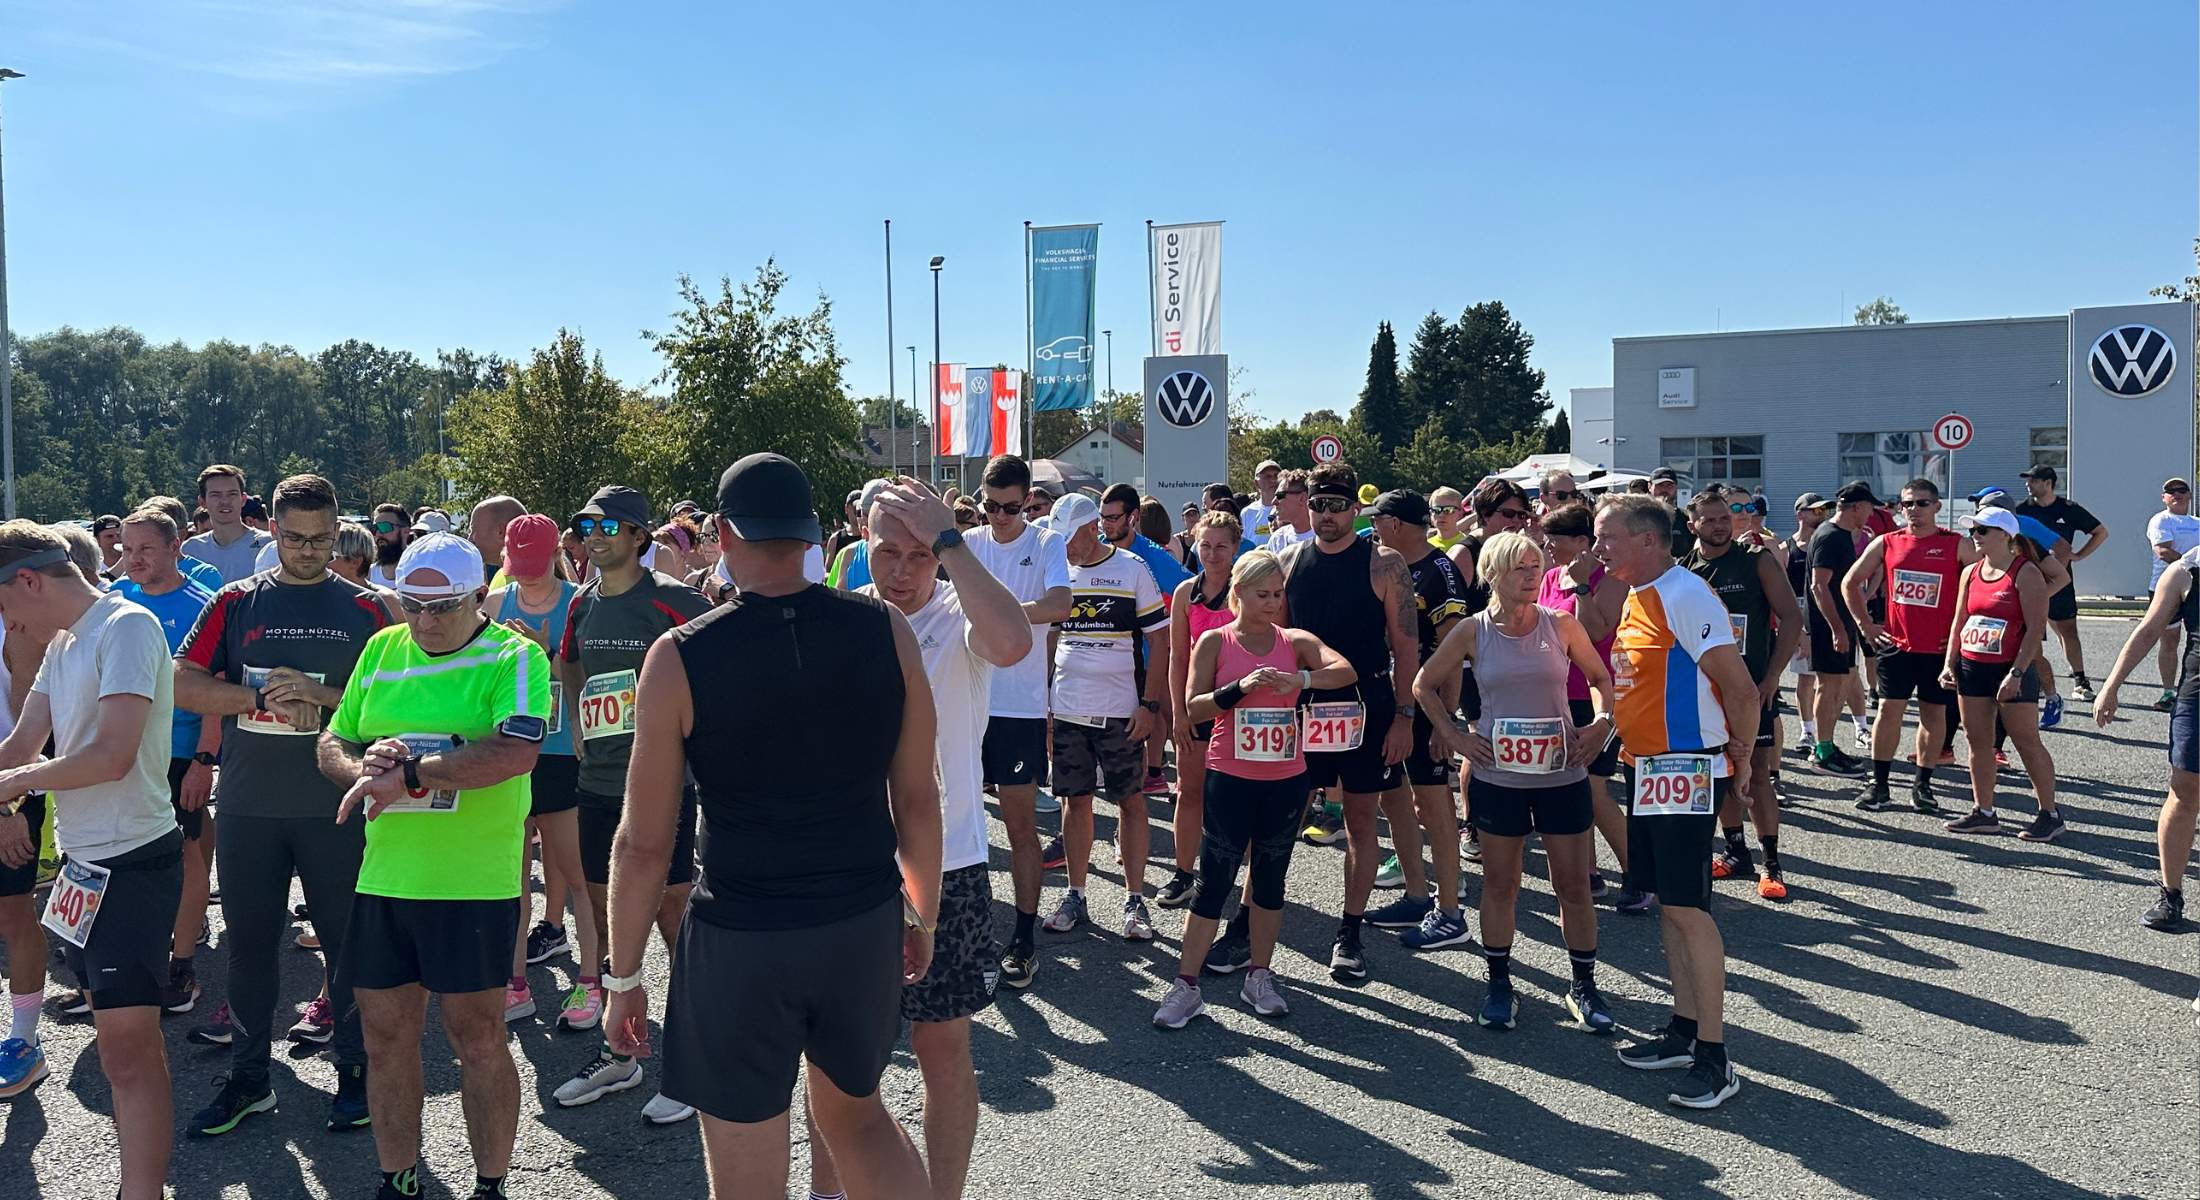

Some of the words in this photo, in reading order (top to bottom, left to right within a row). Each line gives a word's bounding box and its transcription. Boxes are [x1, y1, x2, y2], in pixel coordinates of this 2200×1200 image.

[1164, 233, 1181, 322] Service
[1166, 331, 1182, 353] di
[1945, 425, 1963, 440] 10
[1320, 444, 1335, 458] 10
[1896, 582, 1926, 600] 426
[265, 627, 350, 638] MOTOR-NÜTZEL
[1963, 629, 1989, 647] 204
[582, 695, 619, 729] 370
[1240, 727, 1284, 752] 319
[1308, 720, 1346, 743] 211
[1498, 738, 1549, 764] 387
[1639, 775, 1690, 805] 209
